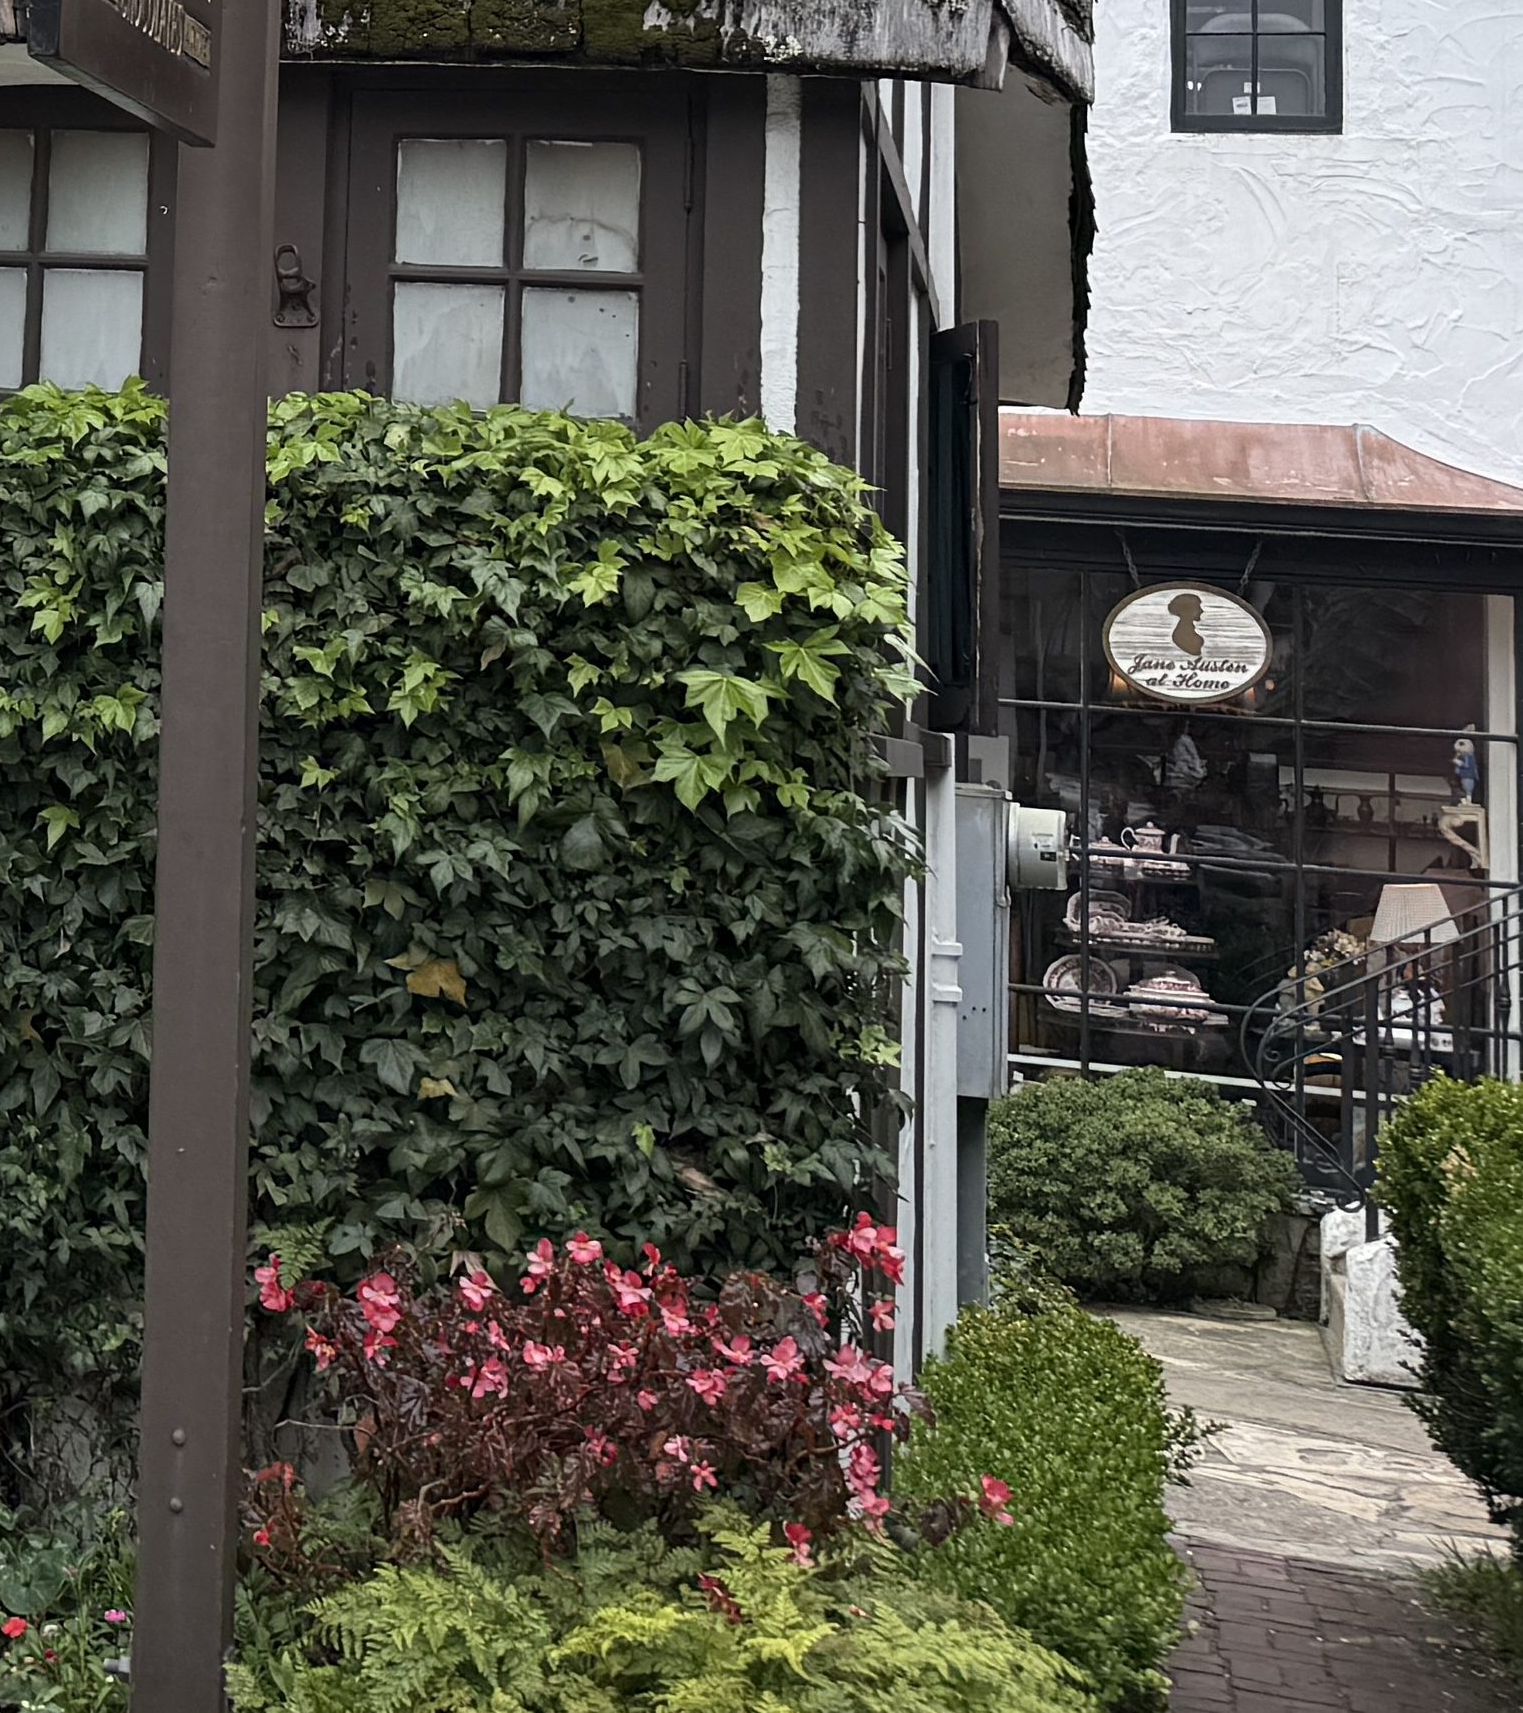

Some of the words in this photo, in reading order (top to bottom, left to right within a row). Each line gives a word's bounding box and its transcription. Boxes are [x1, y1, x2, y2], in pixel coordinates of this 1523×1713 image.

[1127, 653, 1176, 675] Jane
[1179, 656, 1249, 674] Austen
[1146, 672, 1168, 687] at
[1172, 672, 1230, 689] Home
